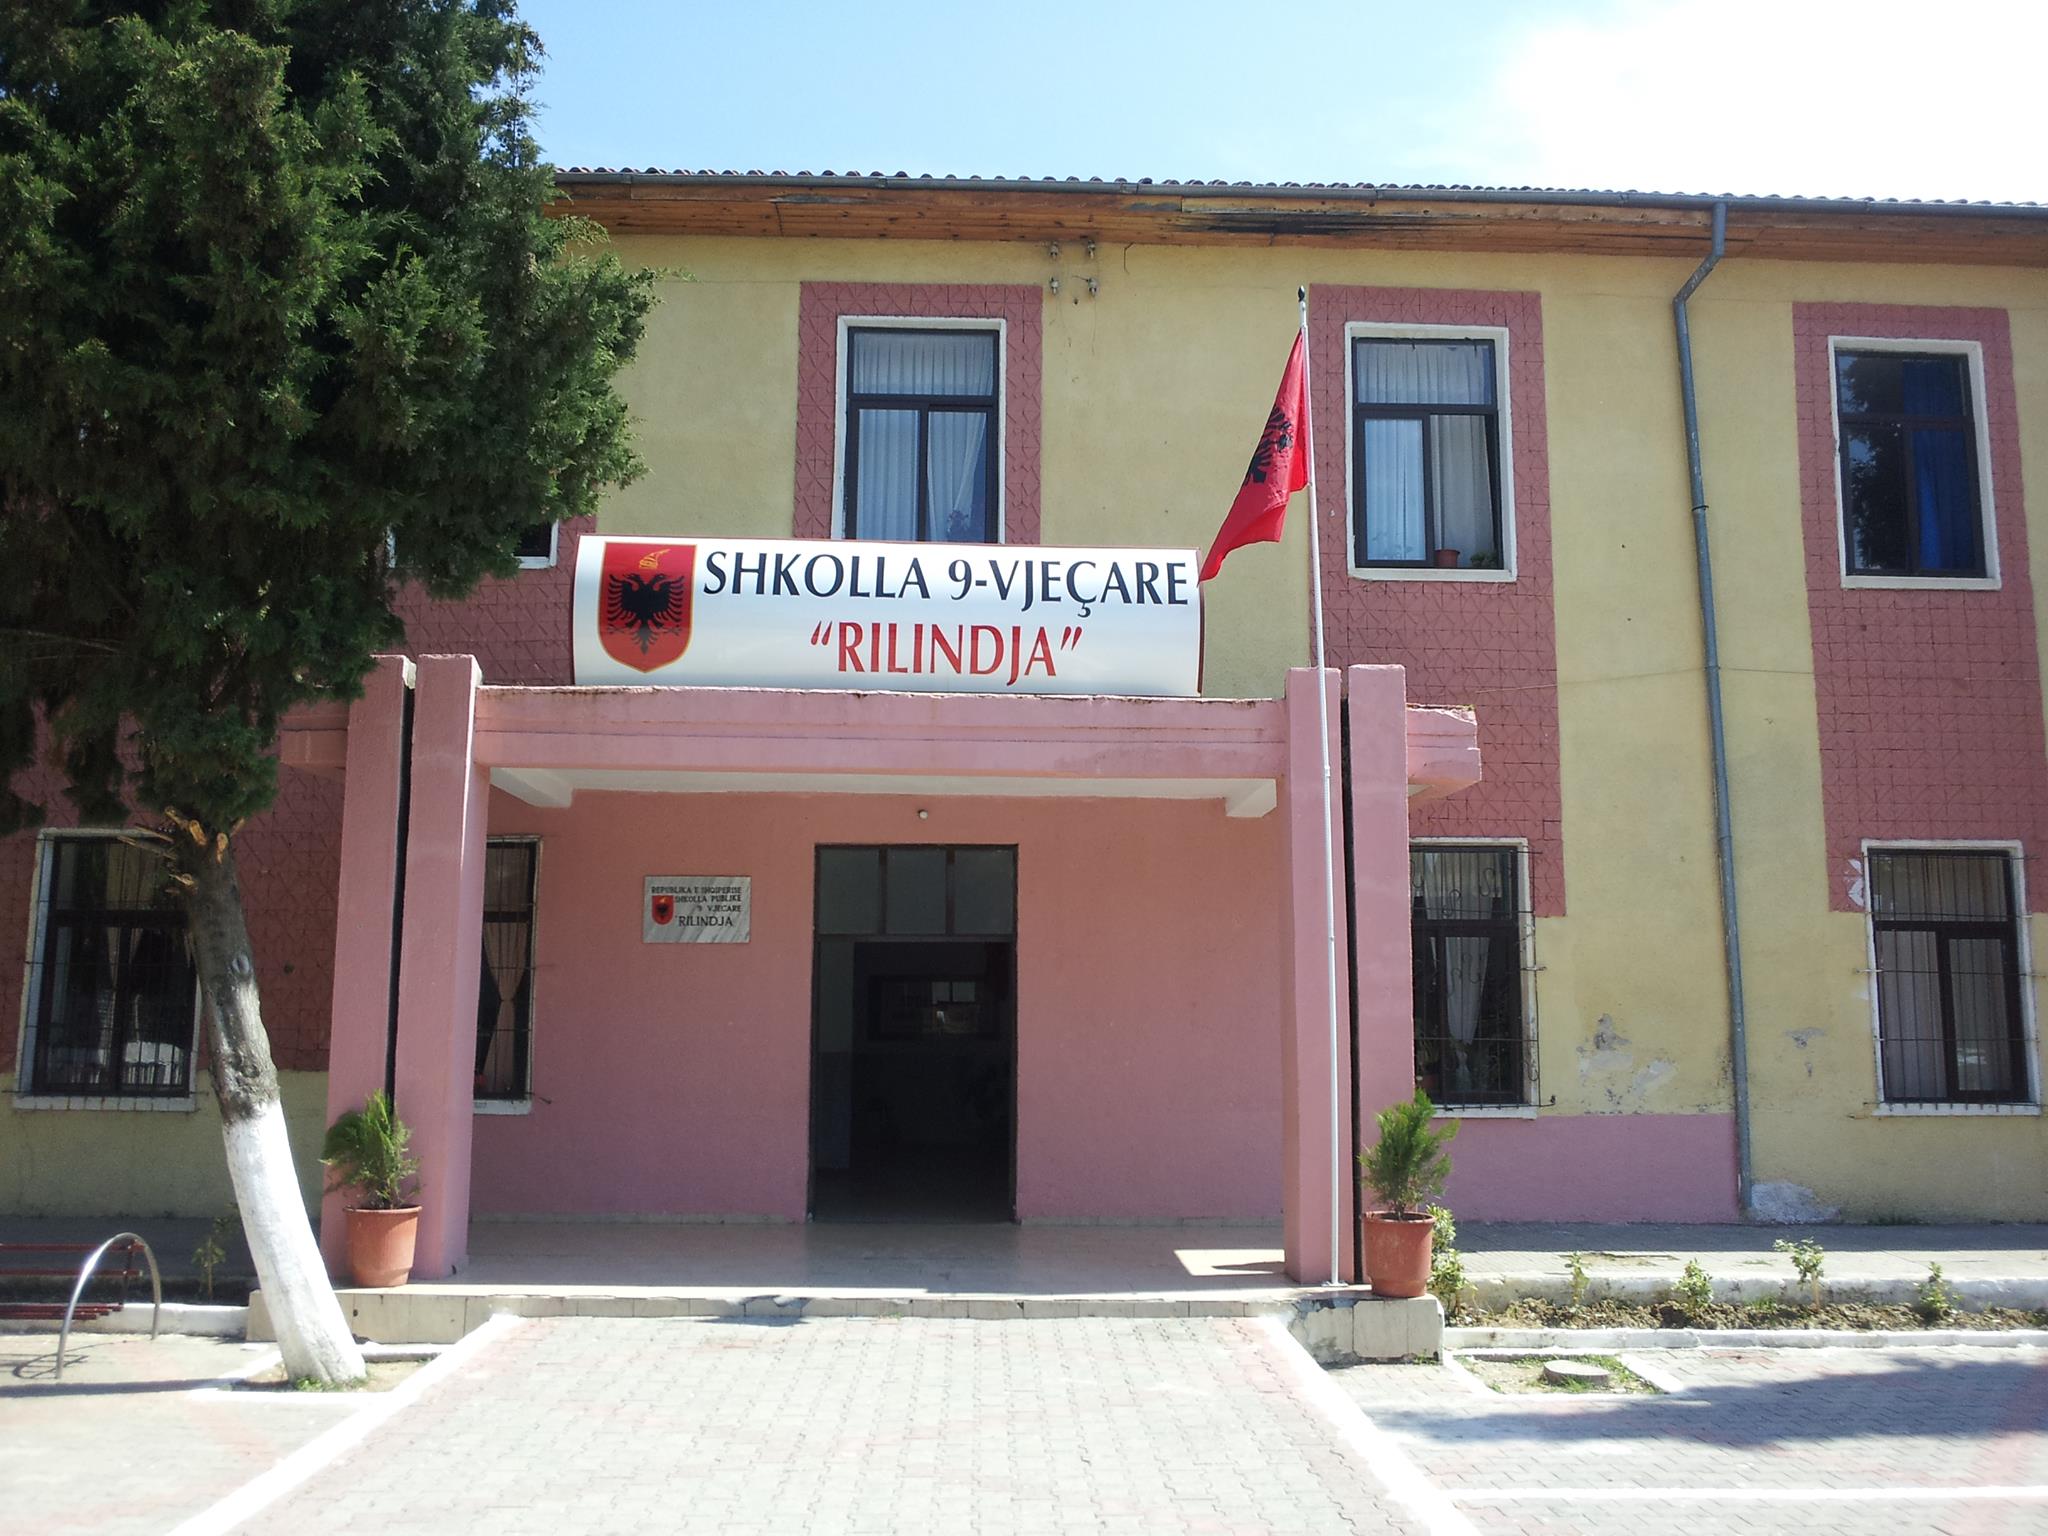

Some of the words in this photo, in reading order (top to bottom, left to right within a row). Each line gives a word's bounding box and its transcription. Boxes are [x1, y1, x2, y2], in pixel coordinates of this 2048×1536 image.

[703, 551, 931, 600] SHKOLLA
[948, 559, 1189, 618] 9-VJEÇARE
[651, 886, 692, 894] REPUBLIKA
[694, 886, 699, 894] E
[675, 895, 707, 903] SHKOLLA
[711, 894, 741, 902] PUBLIKE
